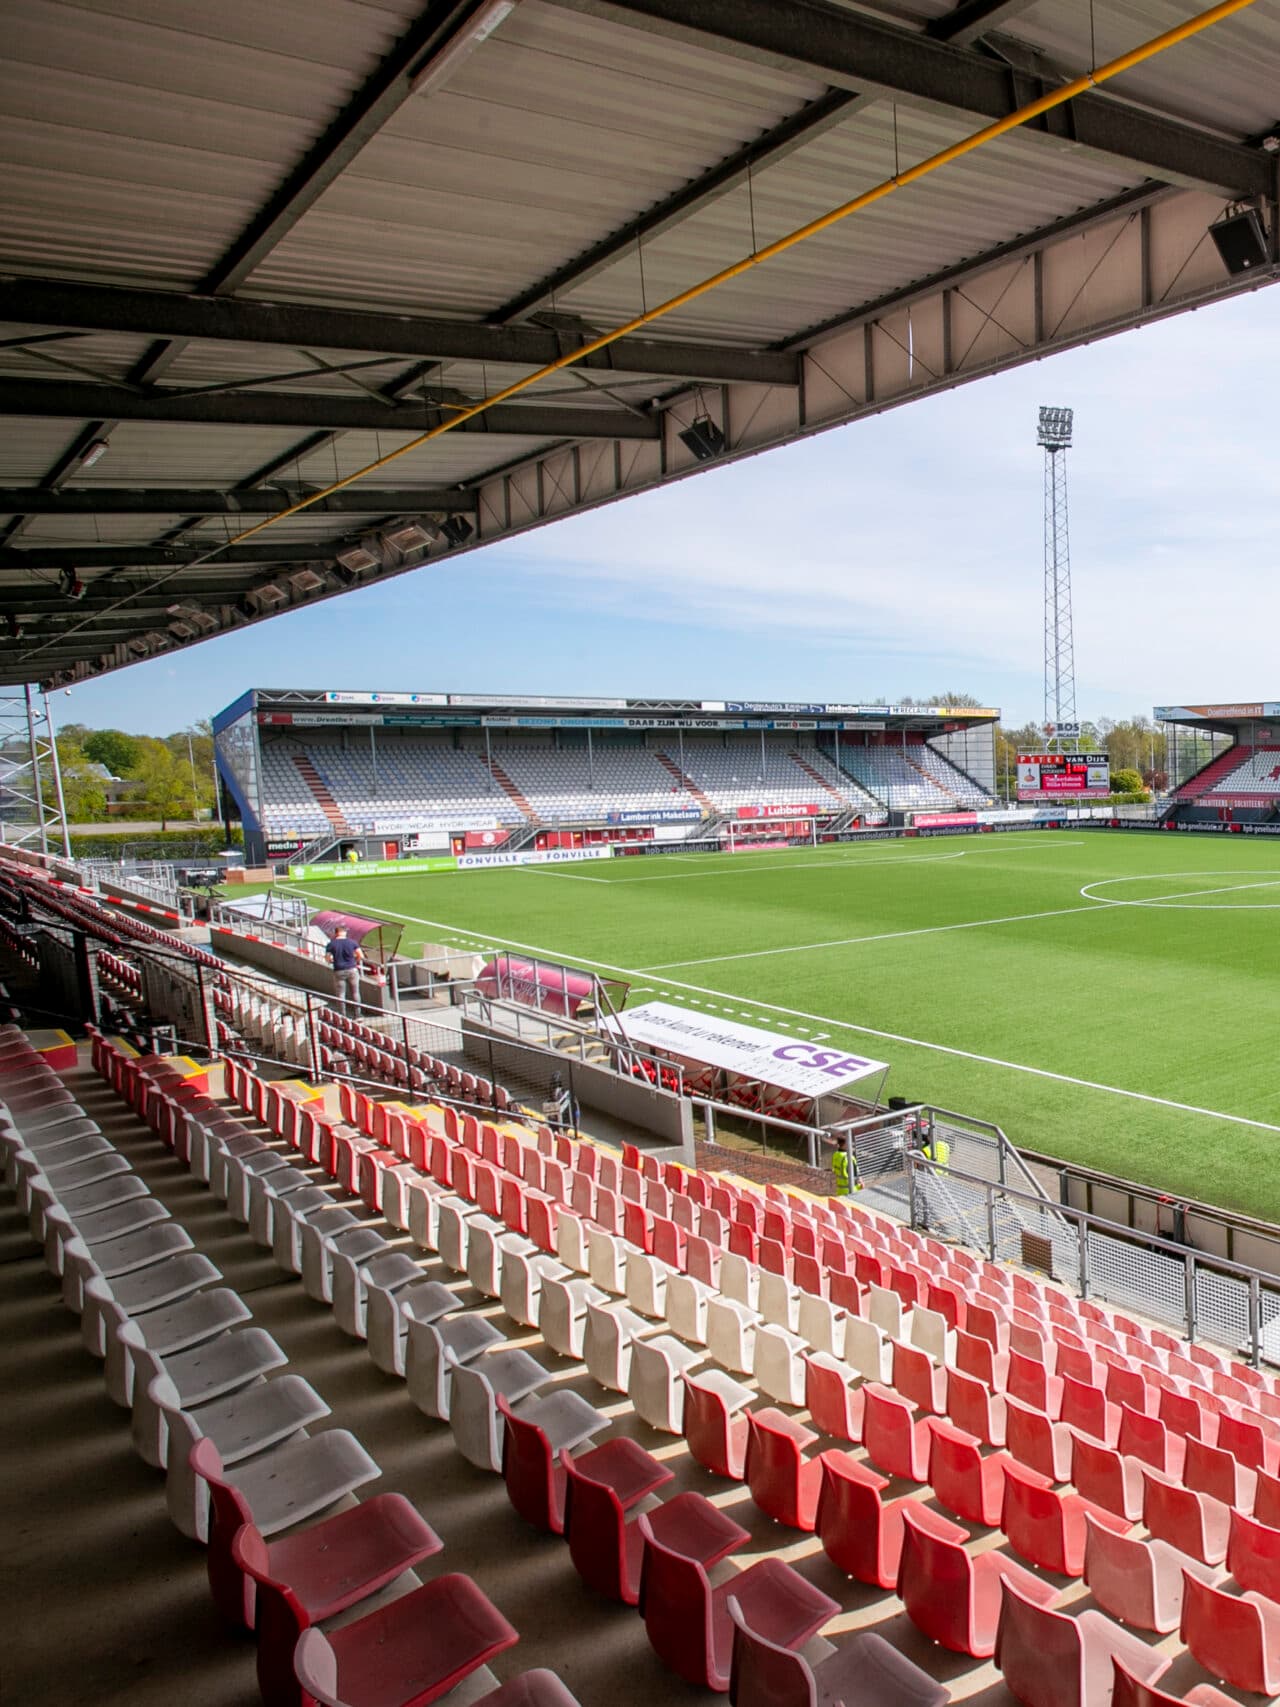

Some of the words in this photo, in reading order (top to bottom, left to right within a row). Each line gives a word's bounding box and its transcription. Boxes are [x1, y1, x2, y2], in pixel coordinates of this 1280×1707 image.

[1056, 722, 1080, 732] BOS
[1086, 755, 1106, 763] DIJK
[767, 805, 808, 816] Lubbers
[459, 855, 517, 865] FONVILLE
[546, 850, 601, 860] FONVILLE
[772, 1044, 871, 1077] CSE
